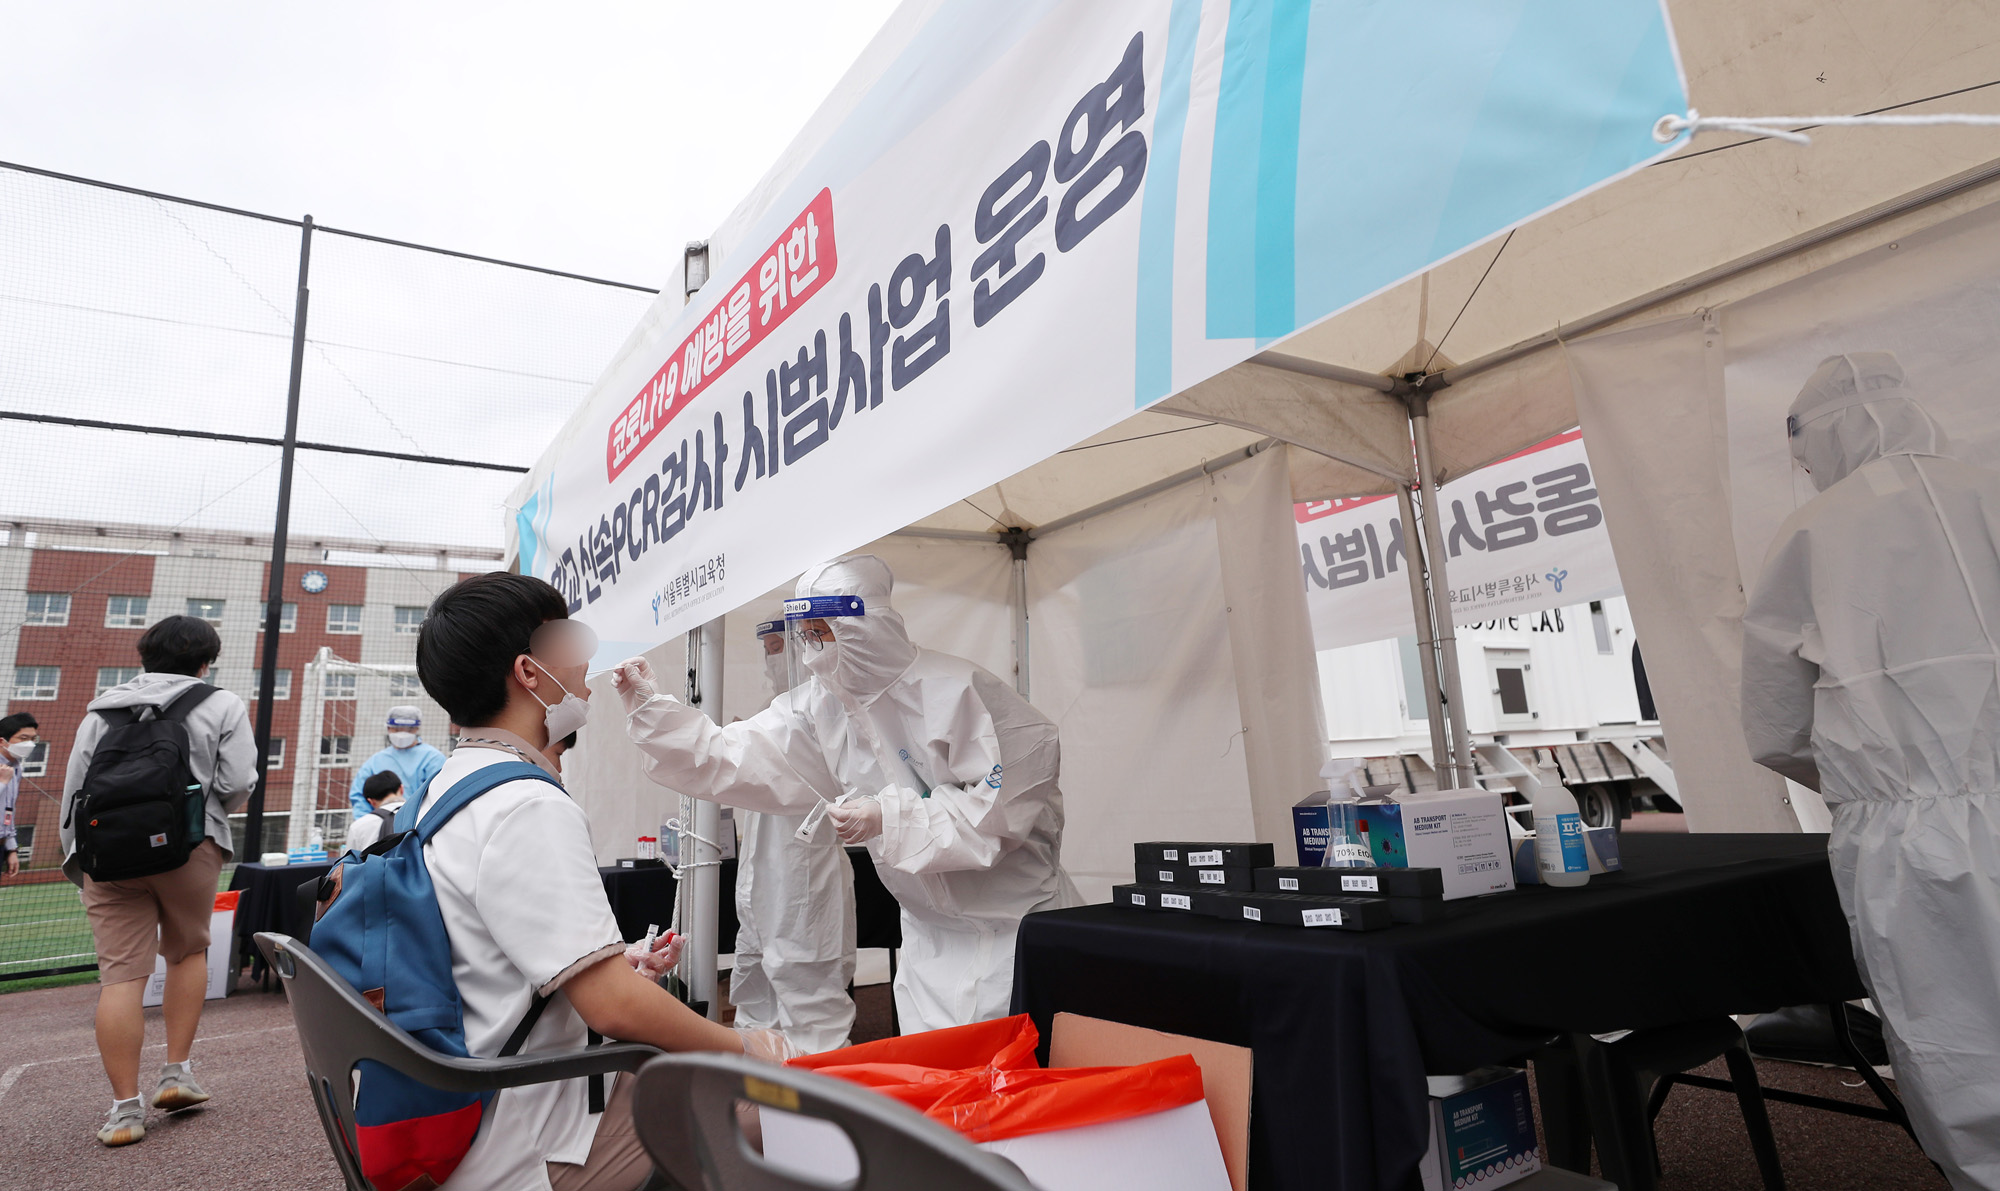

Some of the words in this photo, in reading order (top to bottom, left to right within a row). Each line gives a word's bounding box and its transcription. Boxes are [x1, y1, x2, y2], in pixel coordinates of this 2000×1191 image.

[735, 224, 951, 492] 시범사업
[970, 31, 1148, 328] 운영
[613, 366, 678, 467] 코로나19
[682, 282, 751, 391] 예방을
[760, 211, 819, 327] 위한
[662, 553, 725, 607] 서울특별시교육청
[1421, 814, 1447, 823] TRANSPORT
[1414, 823, 1433, 831] MEDIUM
[1303, 837, 1327, 845] MEDIUM
[1336, 849, 1355, 857] 70%
